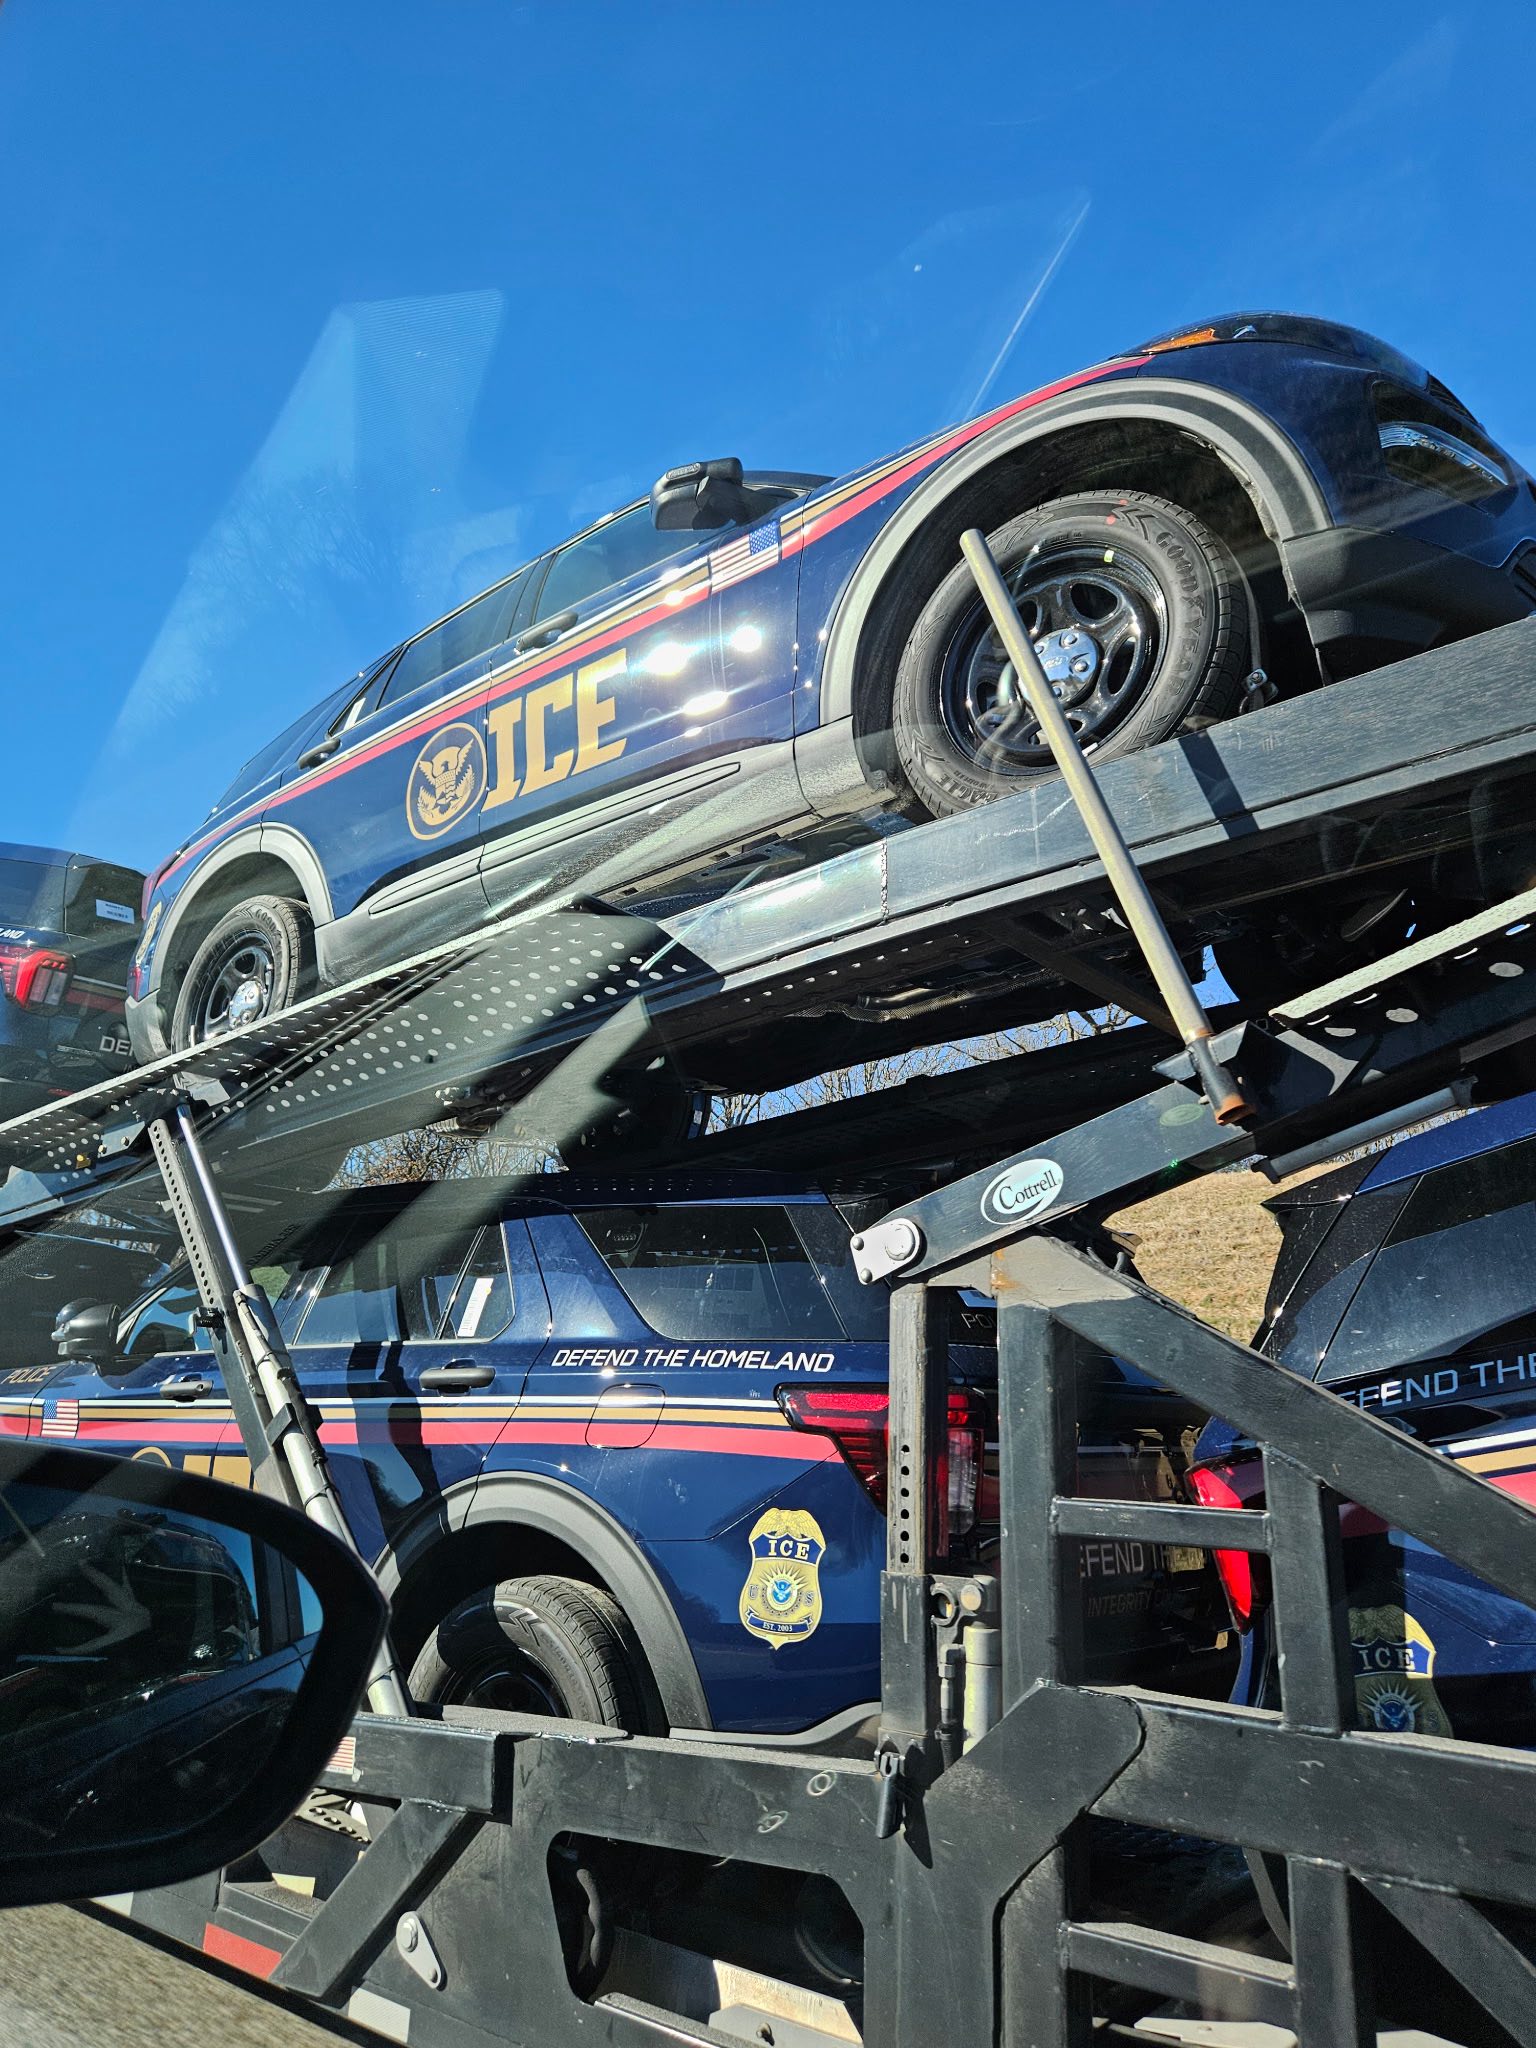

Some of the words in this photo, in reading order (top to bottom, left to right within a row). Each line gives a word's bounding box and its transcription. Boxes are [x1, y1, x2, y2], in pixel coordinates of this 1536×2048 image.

[1155, 531, 1206, 696] GOODYEAR
[481, 648, 627, 812] ICE
[999, 1169, 1058, 1210] Cottrell
[551, 1349, 639, 1367] DEFEND
[643, 1349, 689, 1367] THE
[689, 1349, 835, 1373] HOMELAND
[0, 1366, 56, 1384] POLICE
[768, 1539, 810, 1560] ICE
[762, 1622, 777, 1630] EST.
[777, 1624, 793, 1632] 2003
[1358, 1647, 1416, 1671] ICE
